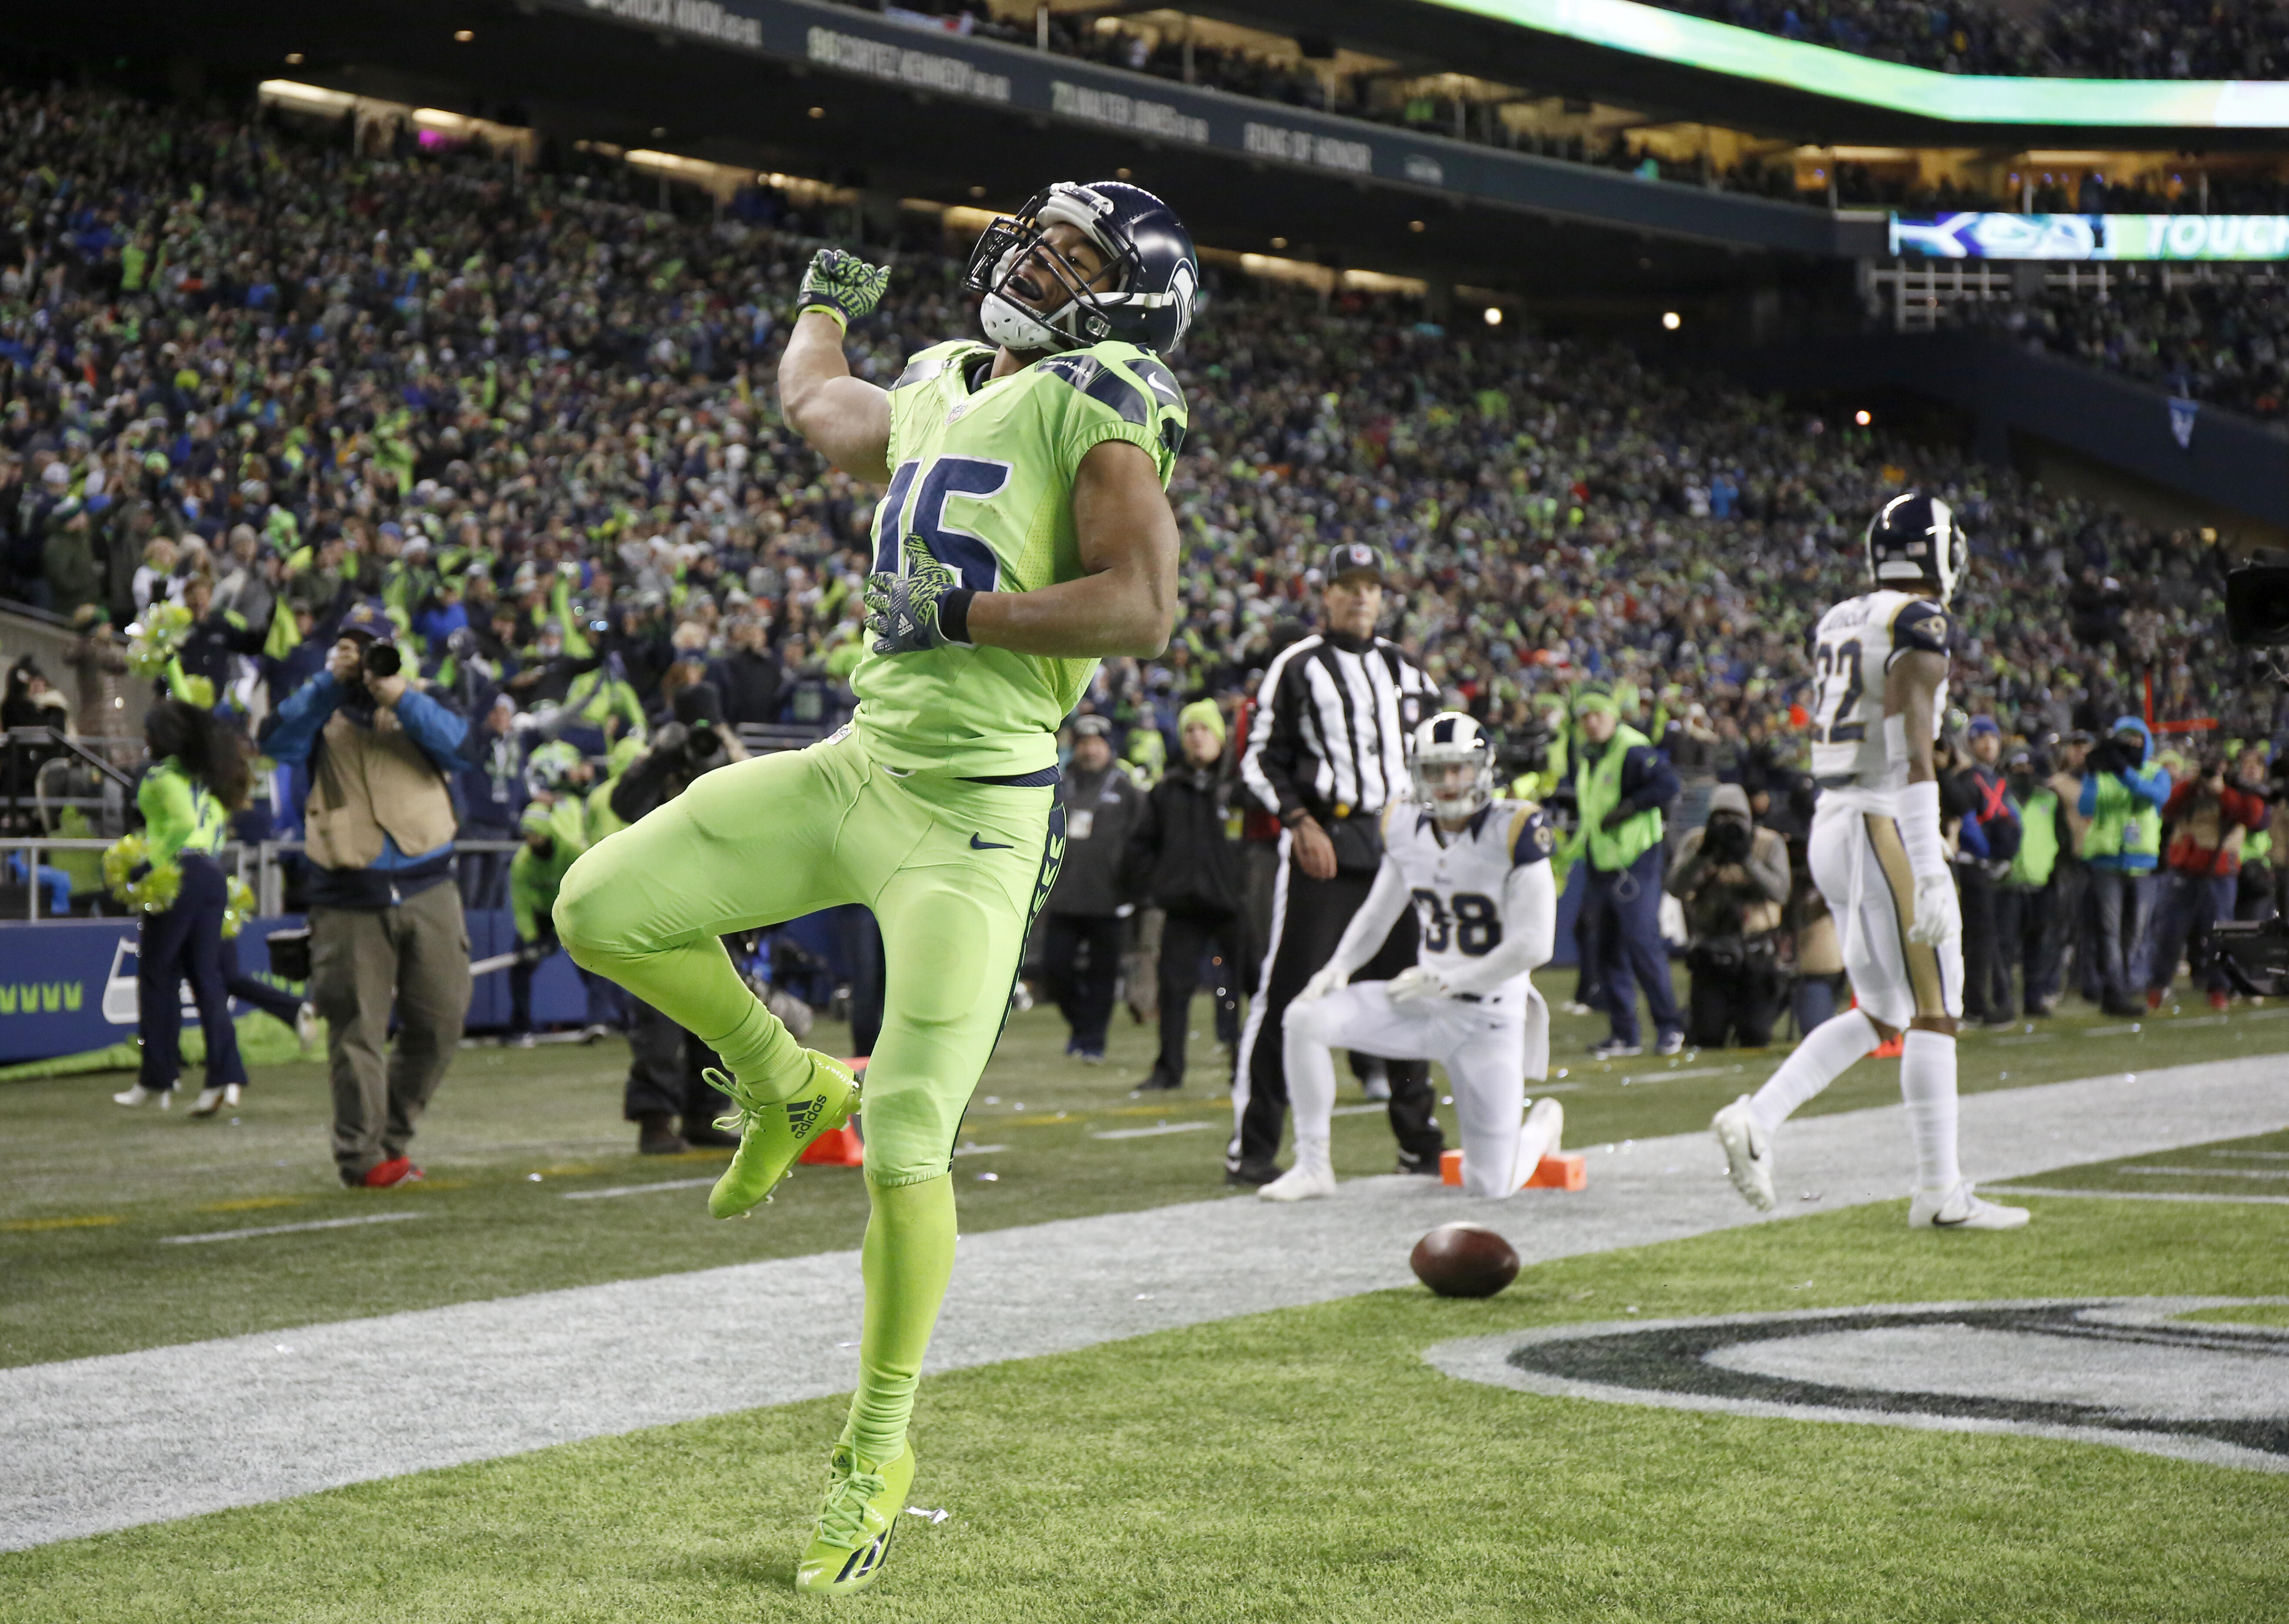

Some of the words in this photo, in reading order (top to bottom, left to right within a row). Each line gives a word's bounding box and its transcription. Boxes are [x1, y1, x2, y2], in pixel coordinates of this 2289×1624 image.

[838, 32, 899, 81] CORTEZ
[900, 50, 974, 92] KENNEDY
[1077, 87, 1132, 126] WALTER
[1133, 99, 1178, 136] JONES
[1243, 121, 1289, 156] RING
[1292, 131, 1312, 161] OF
[1313, 136, 1373, 173] HONOR
[1044, 361, 1091, 378] SEAHAWKS
[872, 453, 1014, 592] 15
[898, 623, 914, 637] adidas
[1411, 887, 1504, 957] 38
[795, 1094, 827, 1139] adidas
